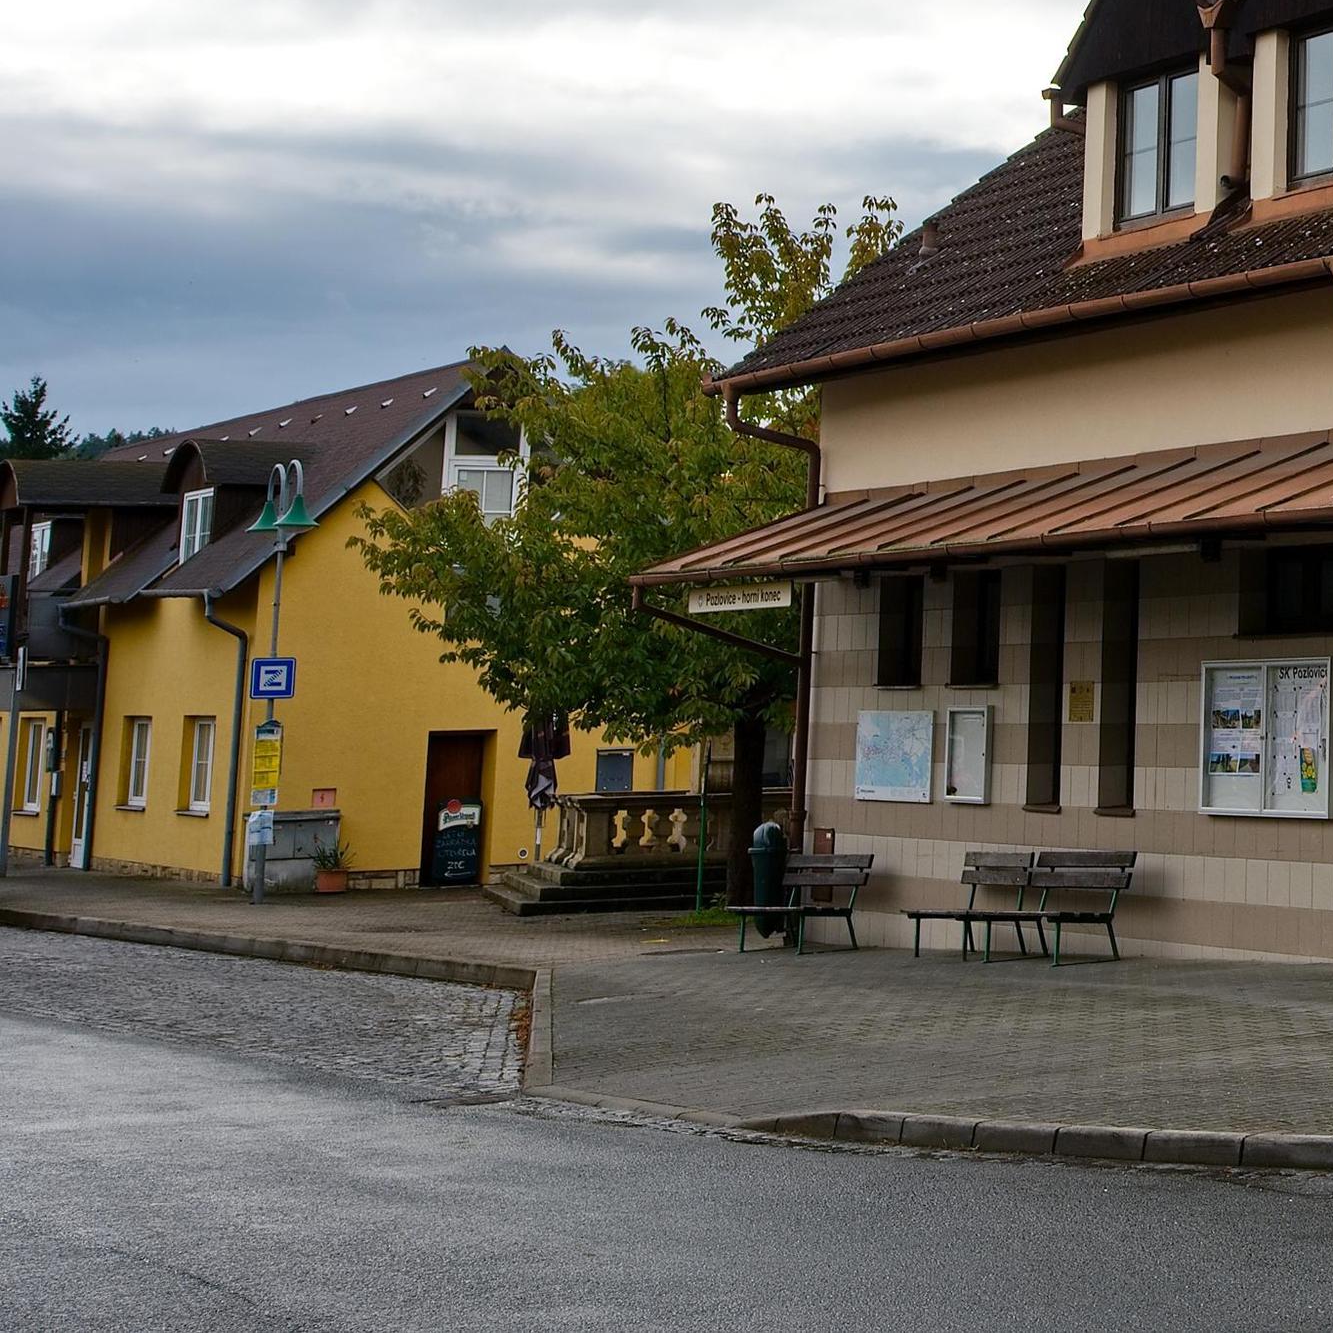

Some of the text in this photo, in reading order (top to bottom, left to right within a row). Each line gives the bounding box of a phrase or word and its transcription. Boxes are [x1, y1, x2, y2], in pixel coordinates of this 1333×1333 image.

[706, 591, 737, 606] Pozlovice
[742, 588, 759, 604] horní
[760, 589, 781, 603] konec
[1279, 666, 1290, 679] SK
